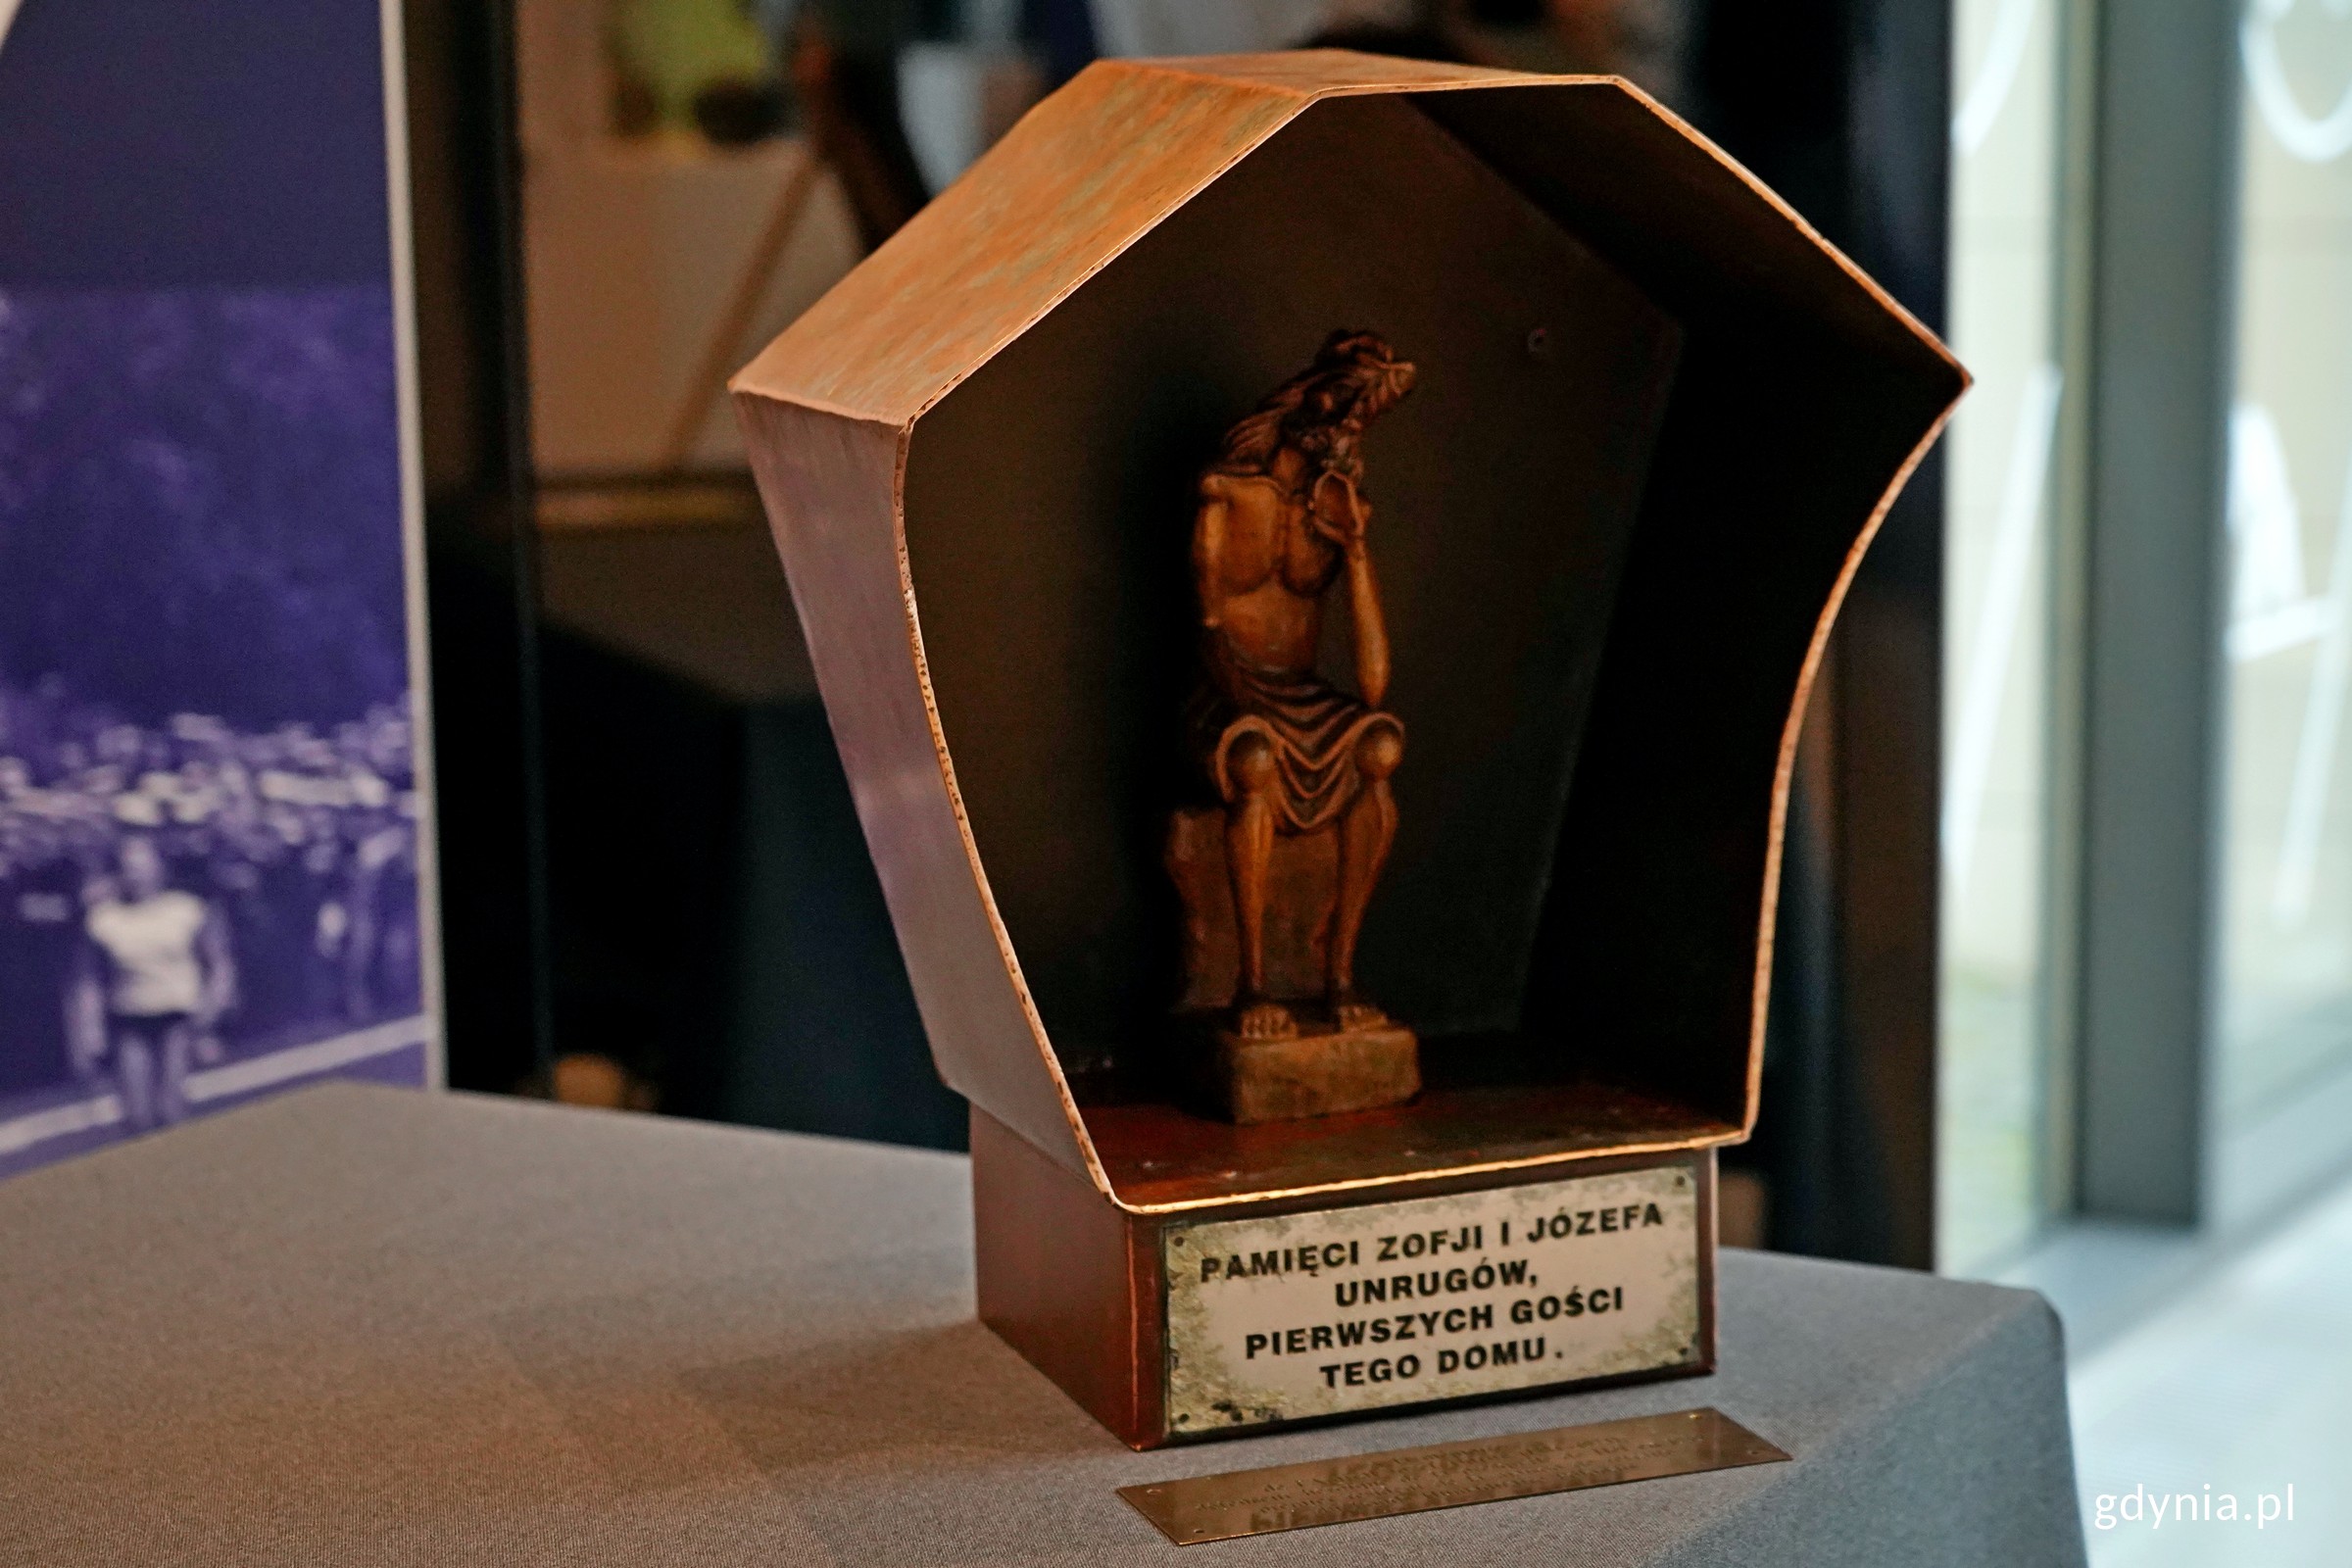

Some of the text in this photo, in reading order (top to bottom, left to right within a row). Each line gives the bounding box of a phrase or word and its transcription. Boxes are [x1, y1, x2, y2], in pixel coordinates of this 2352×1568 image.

[1200, 1202, 1664, 1284] PAMIĘCI ZOFJI I JÓZEFA
[1334, 1256, 1539, 1307] UNRUGÓW,
[1245, 1286, 1624, 1359] PIERWSZYCH GOŚCI
[1319, 1354, 1421, 1390] TEGO
